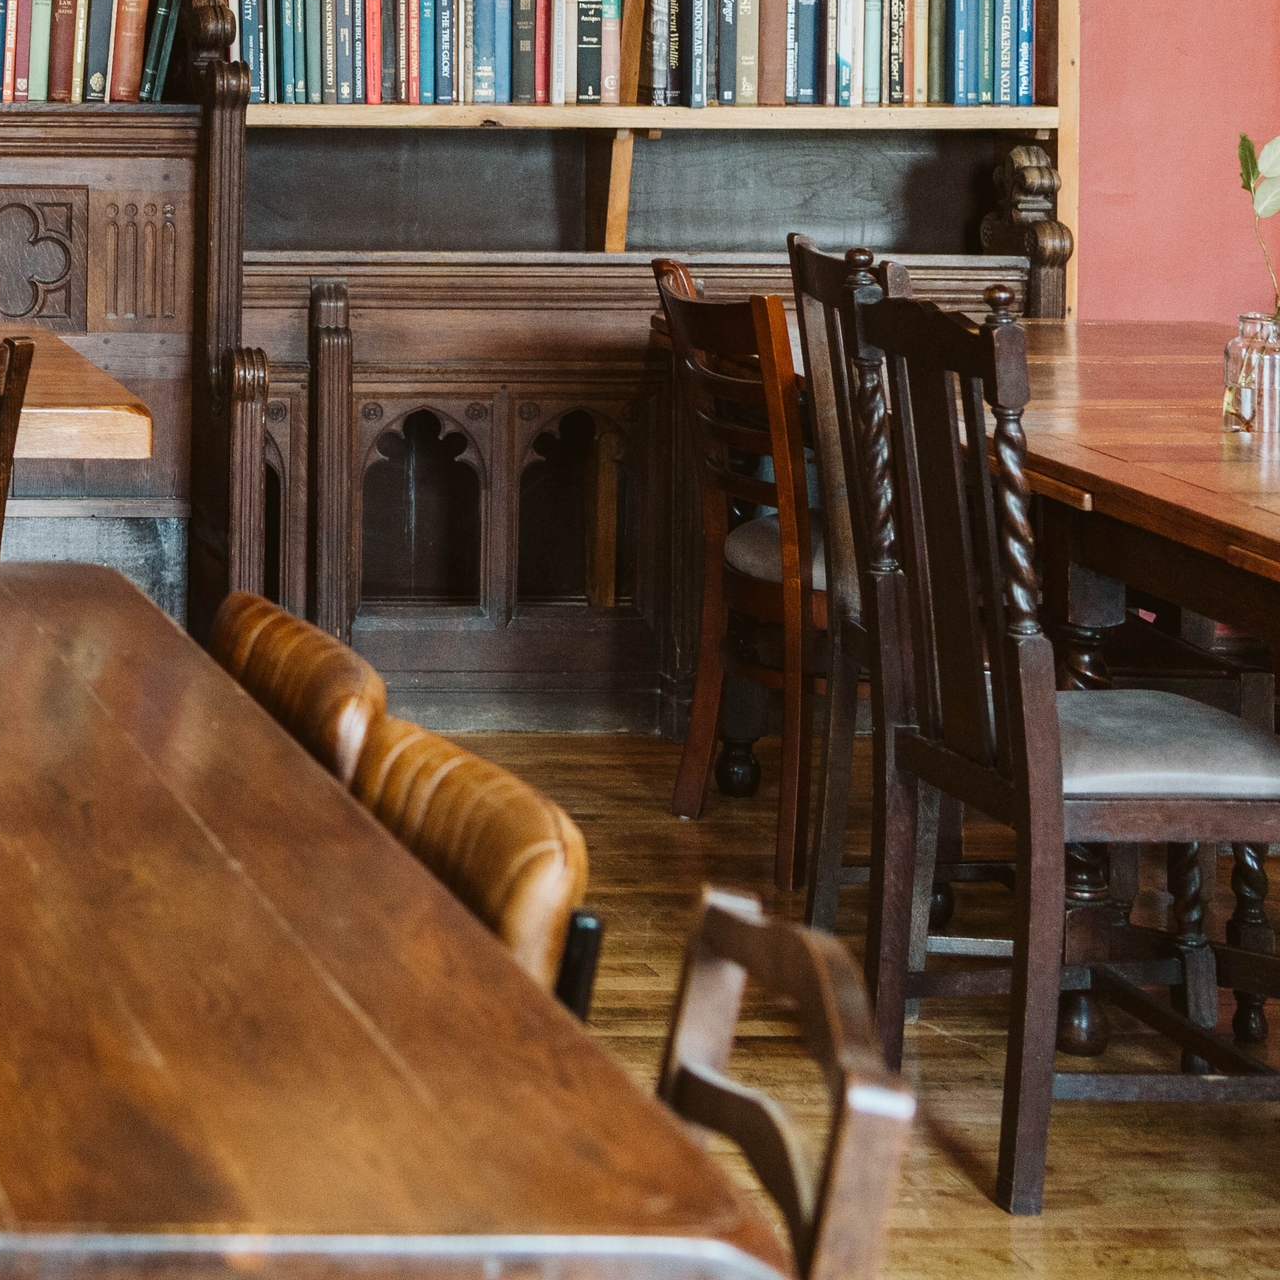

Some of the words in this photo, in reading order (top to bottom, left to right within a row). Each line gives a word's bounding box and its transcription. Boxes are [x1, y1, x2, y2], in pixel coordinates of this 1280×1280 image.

[670, 35, 679, 69] Wildlife
[1020, 42, 1029, 74] Whale
[1020, 76, 1029, 96] The
